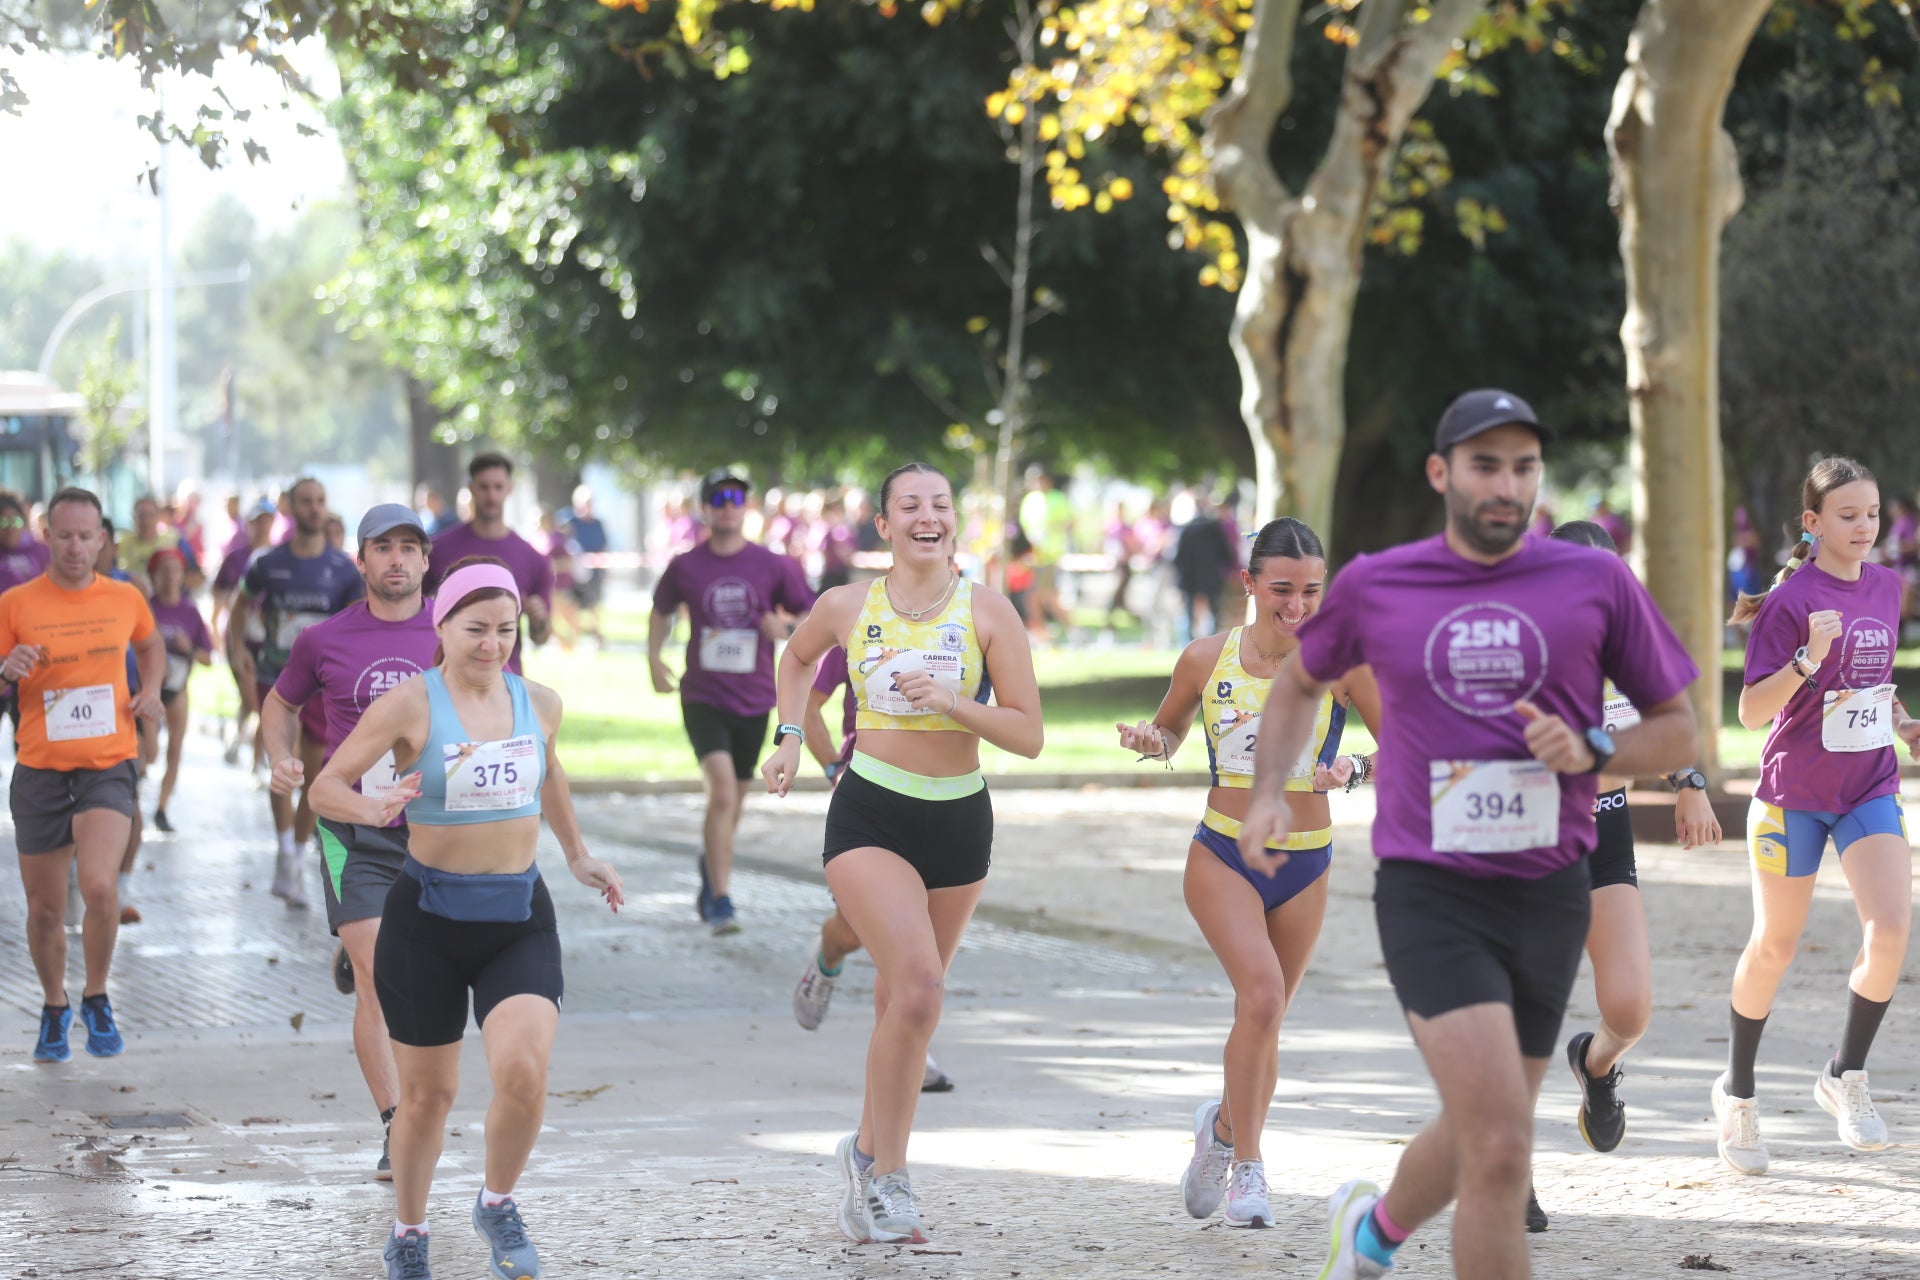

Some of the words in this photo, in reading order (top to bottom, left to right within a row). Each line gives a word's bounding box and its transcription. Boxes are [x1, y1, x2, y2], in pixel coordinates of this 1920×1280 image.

[1447, 618, 1520, 648] 25N
[1852, 629, 1889, 648] 25N
[922, 654, 958, 662] CARRERA
[70, 703, 92, 721] 40
[1846, 706, 1878, 729] 754
[473, 761, 518, 788] 375
[1465, 792, 1525, 820] 394
